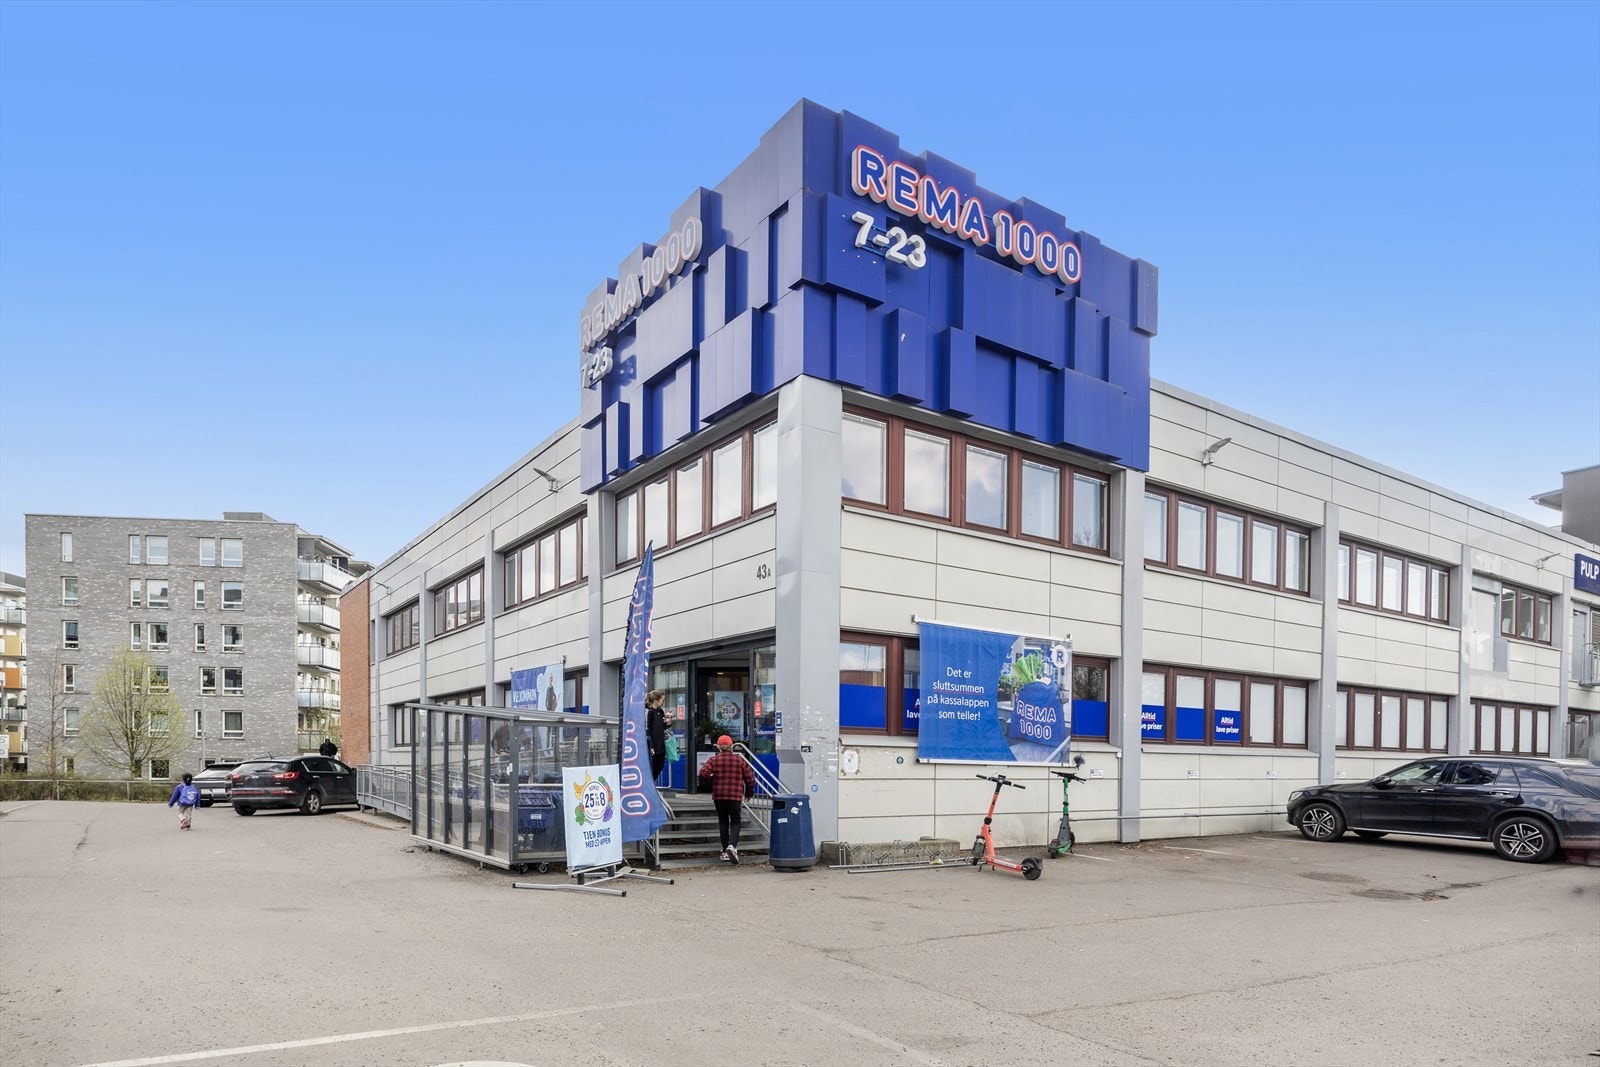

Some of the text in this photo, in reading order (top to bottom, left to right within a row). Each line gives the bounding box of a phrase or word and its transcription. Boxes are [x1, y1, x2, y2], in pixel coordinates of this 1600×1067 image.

[852, 145, 1082, 285] REMA 1000
[852, 211, 926, 270] 7-23
[580, 217, 702, 352] REMA 1000
[581, 346, 613, 389] 7-23
[1580, 560, 1600, 580] PULP
[946, 666, 972, 678] Det er
[932, 680, 984, 694] sluttsummen
[928, 694, 938, 704] på
[940, 695, 990, 708] kassalappen
[1016, 700, 1056, 722] REMA
[938, 710, 954, 719] som
[957, 710, 980, 720] teller!
[1020, 718, 1052, 740] 1000
[585, 793, 594, 808] 25
[600, 792, 606, 806] 8
[583, 827, 611, 840] TJEN BONUS
